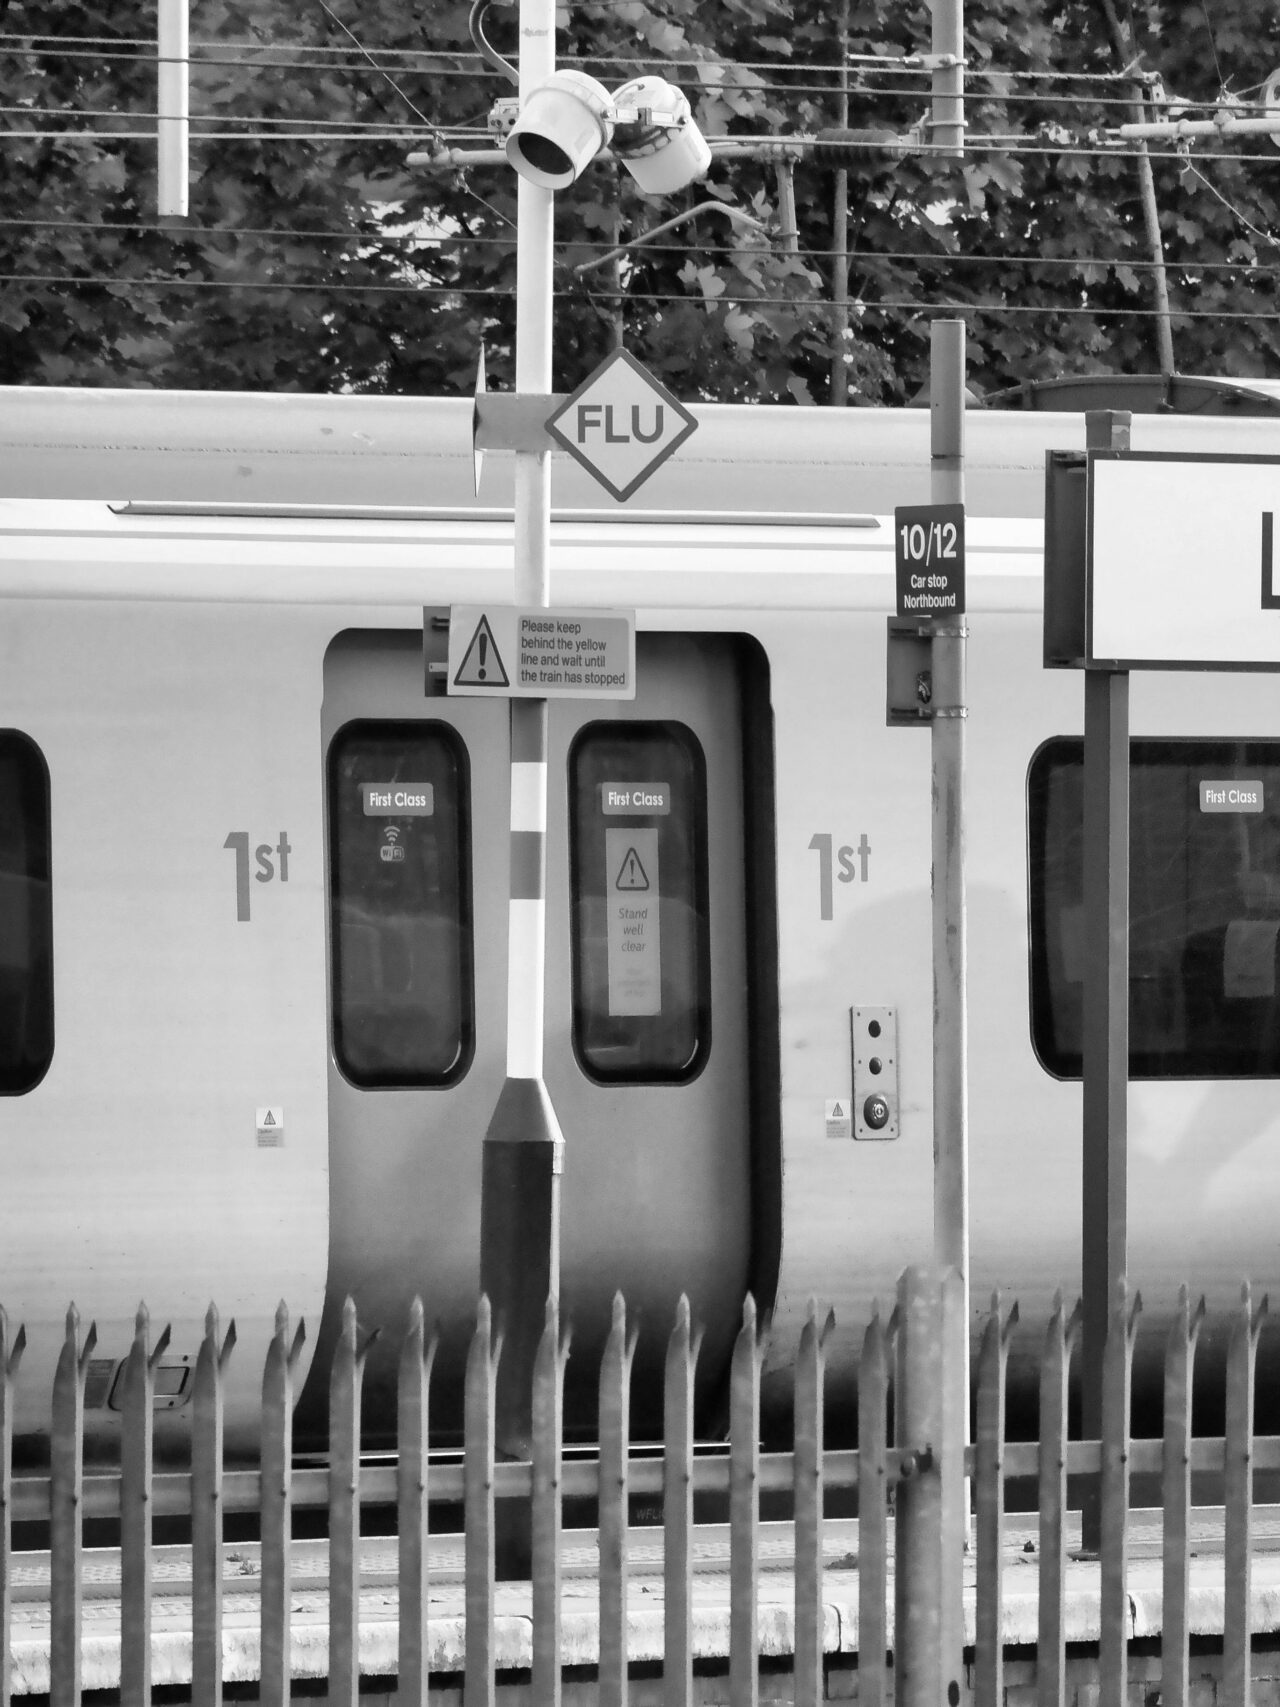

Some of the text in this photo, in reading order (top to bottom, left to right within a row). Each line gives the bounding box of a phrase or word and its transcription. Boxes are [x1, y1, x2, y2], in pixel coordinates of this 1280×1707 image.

[577, 404, 664, 444] FLU
[901, 521, 957, 566] 10/12
[911, 573, 948, 590] Car stop
[904, 592, 956, 608] Northbound
[521, 619, 582, 636] Please keep
[521, 636, 607, 653] behind the yellow
[521, 652, 606, 668] line and wait until
[520, 669, 626, 687] the train has stopped
[369, 791, 426, 807] First Class
[608, 791, 664, 806] First Class
[1205, 789, 1258, 804] First Class
[223, 831, 292, 922] 1st
[807, 833, 872, 921] 1st
[618, 907, 648, 920] Stand
[622, 923, 644, 936] well
[620, 940, 647, 952] clear
